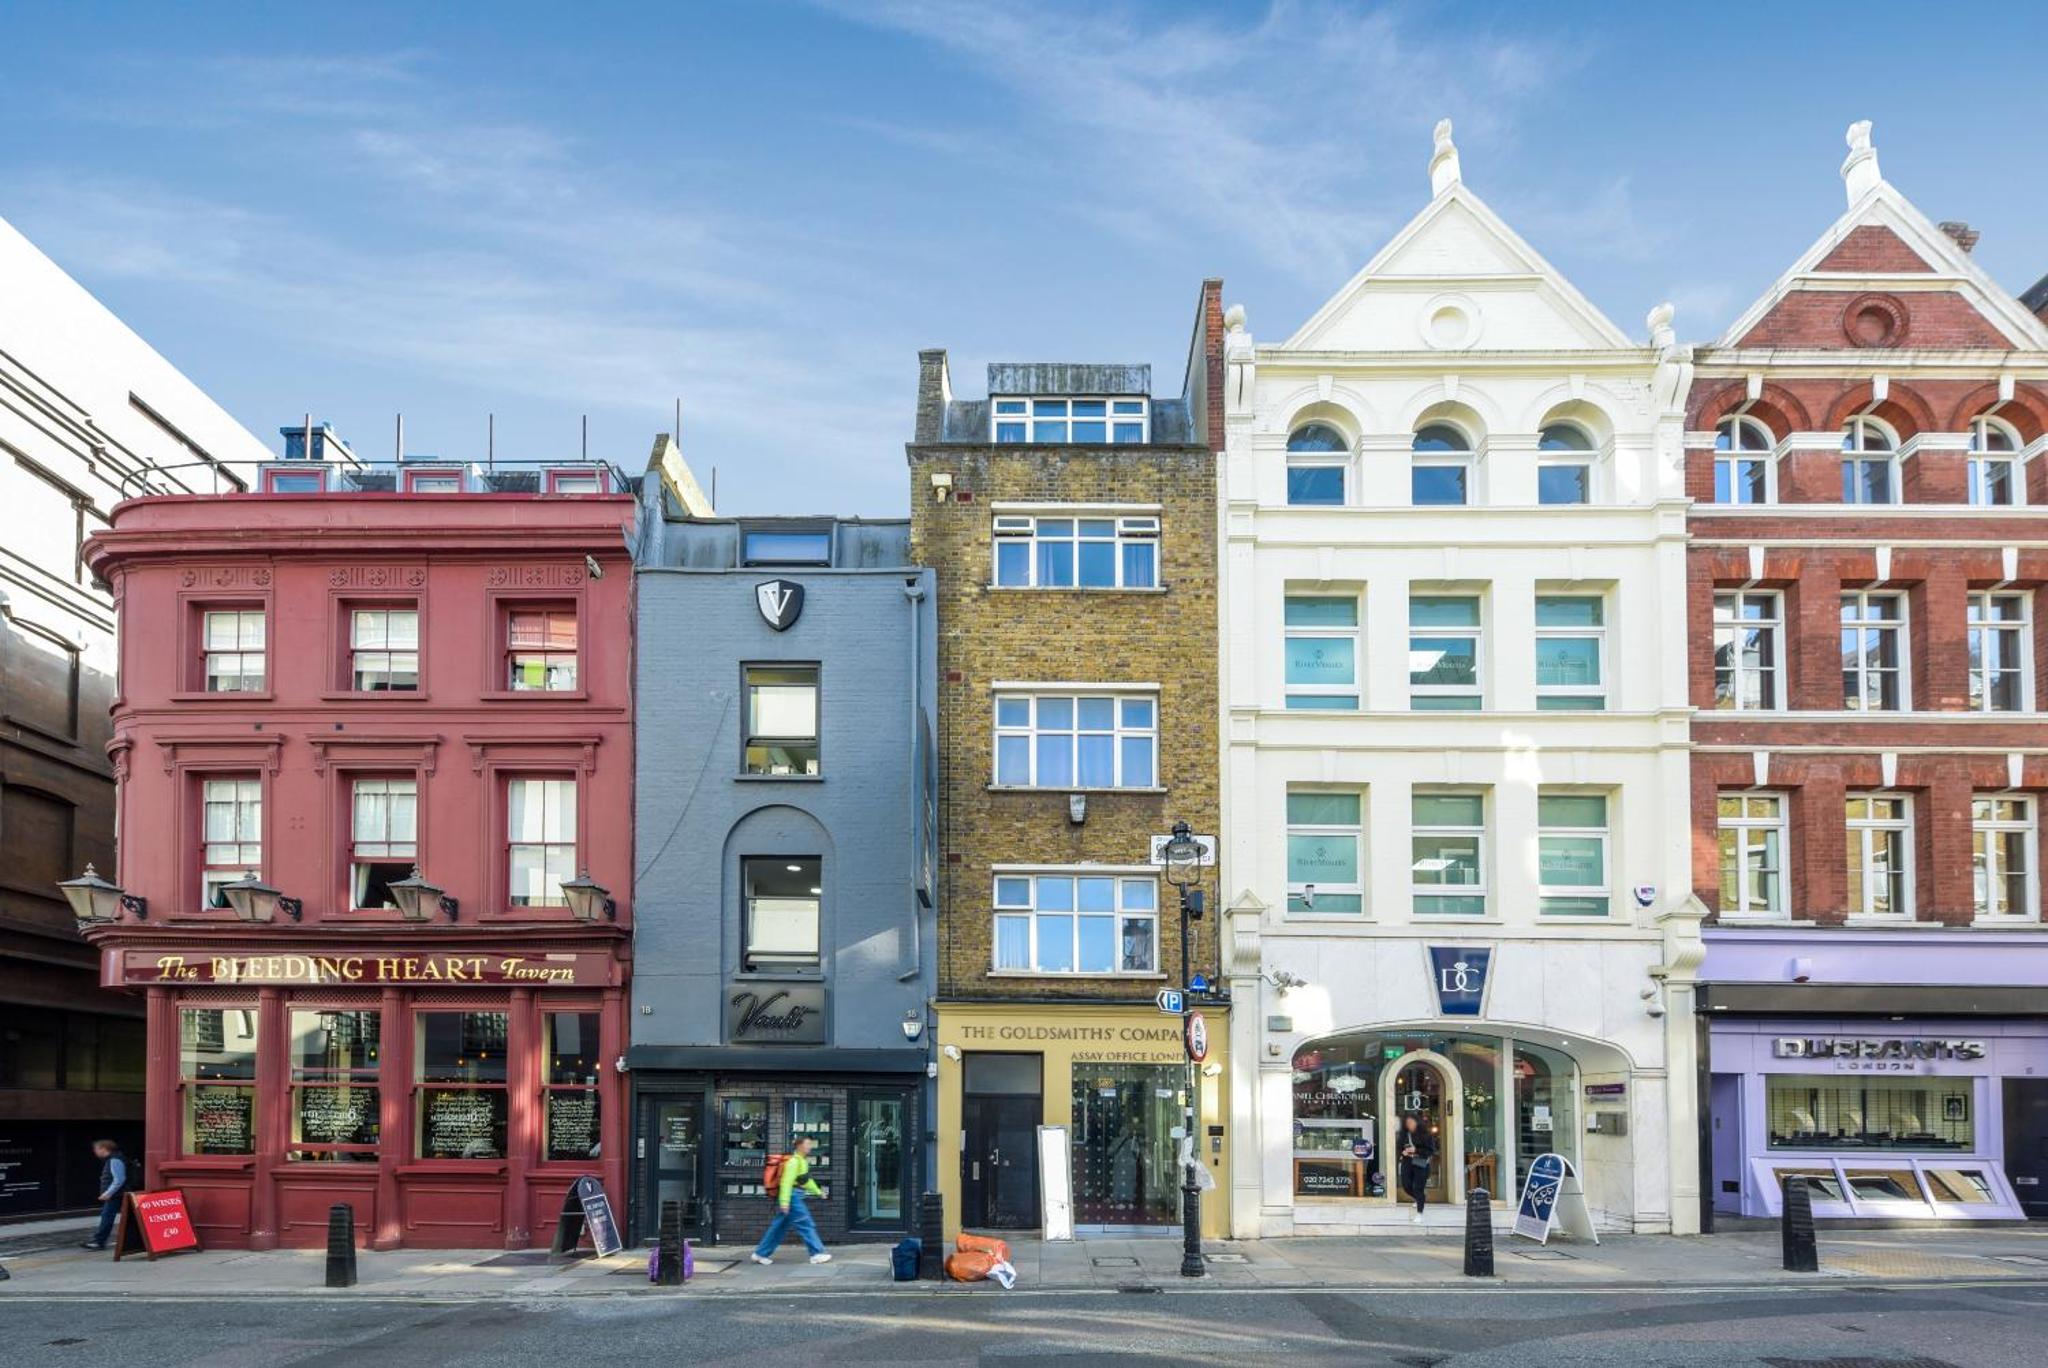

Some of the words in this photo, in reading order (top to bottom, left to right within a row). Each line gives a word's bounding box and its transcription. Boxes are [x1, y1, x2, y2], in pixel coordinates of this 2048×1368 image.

[764, 589, 793, 617] V
[157, 956, 198, 979] The
[209, 957, 364, 980] BLEEDING
[377, 957, 488, 980] HEART
[500, 957, 575, 980] Tavern
[1171, 993, 1178, 1010] P
[731, 991, 819, 1036] Vault
[961, 1026, 995, 1039] THE
[1000, 1026, 1115, 1040] GOLDSMITHS'
[1120, 1027, 1184, 1042] COMPA
[1071, 1051, 1103, 1061] ASSAY
[1106, 1051, 1148, 1061] OFFICE
[1151, 1052, 1184, 1062] LOND
[1775, 1038, 1986, 1060] DURRANTS
[1836, 1062, 1915, 1070] LONDON
[151, 1198, 182, 1207] WINES
[149, 1212, 182, 1223] UNDER
